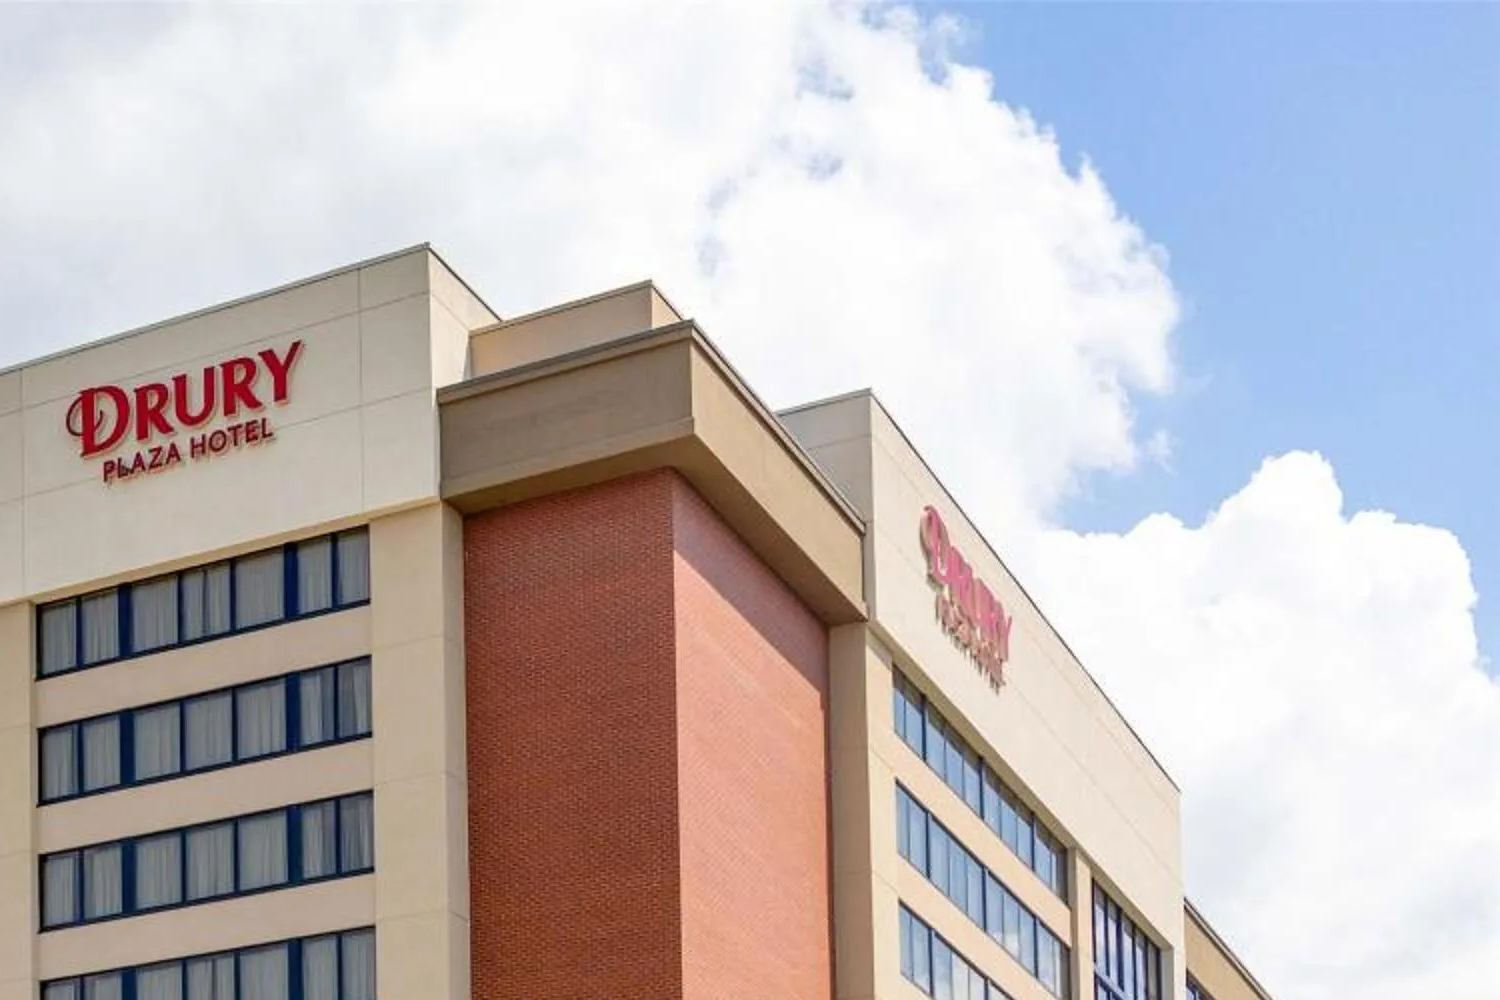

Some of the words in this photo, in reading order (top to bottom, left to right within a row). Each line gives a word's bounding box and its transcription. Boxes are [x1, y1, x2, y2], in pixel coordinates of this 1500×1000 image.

[65, 340, 303, 458] DRURY
[103, 442, 182, 482] PLAZA
[189, 417, 274, 459] HOTEL
